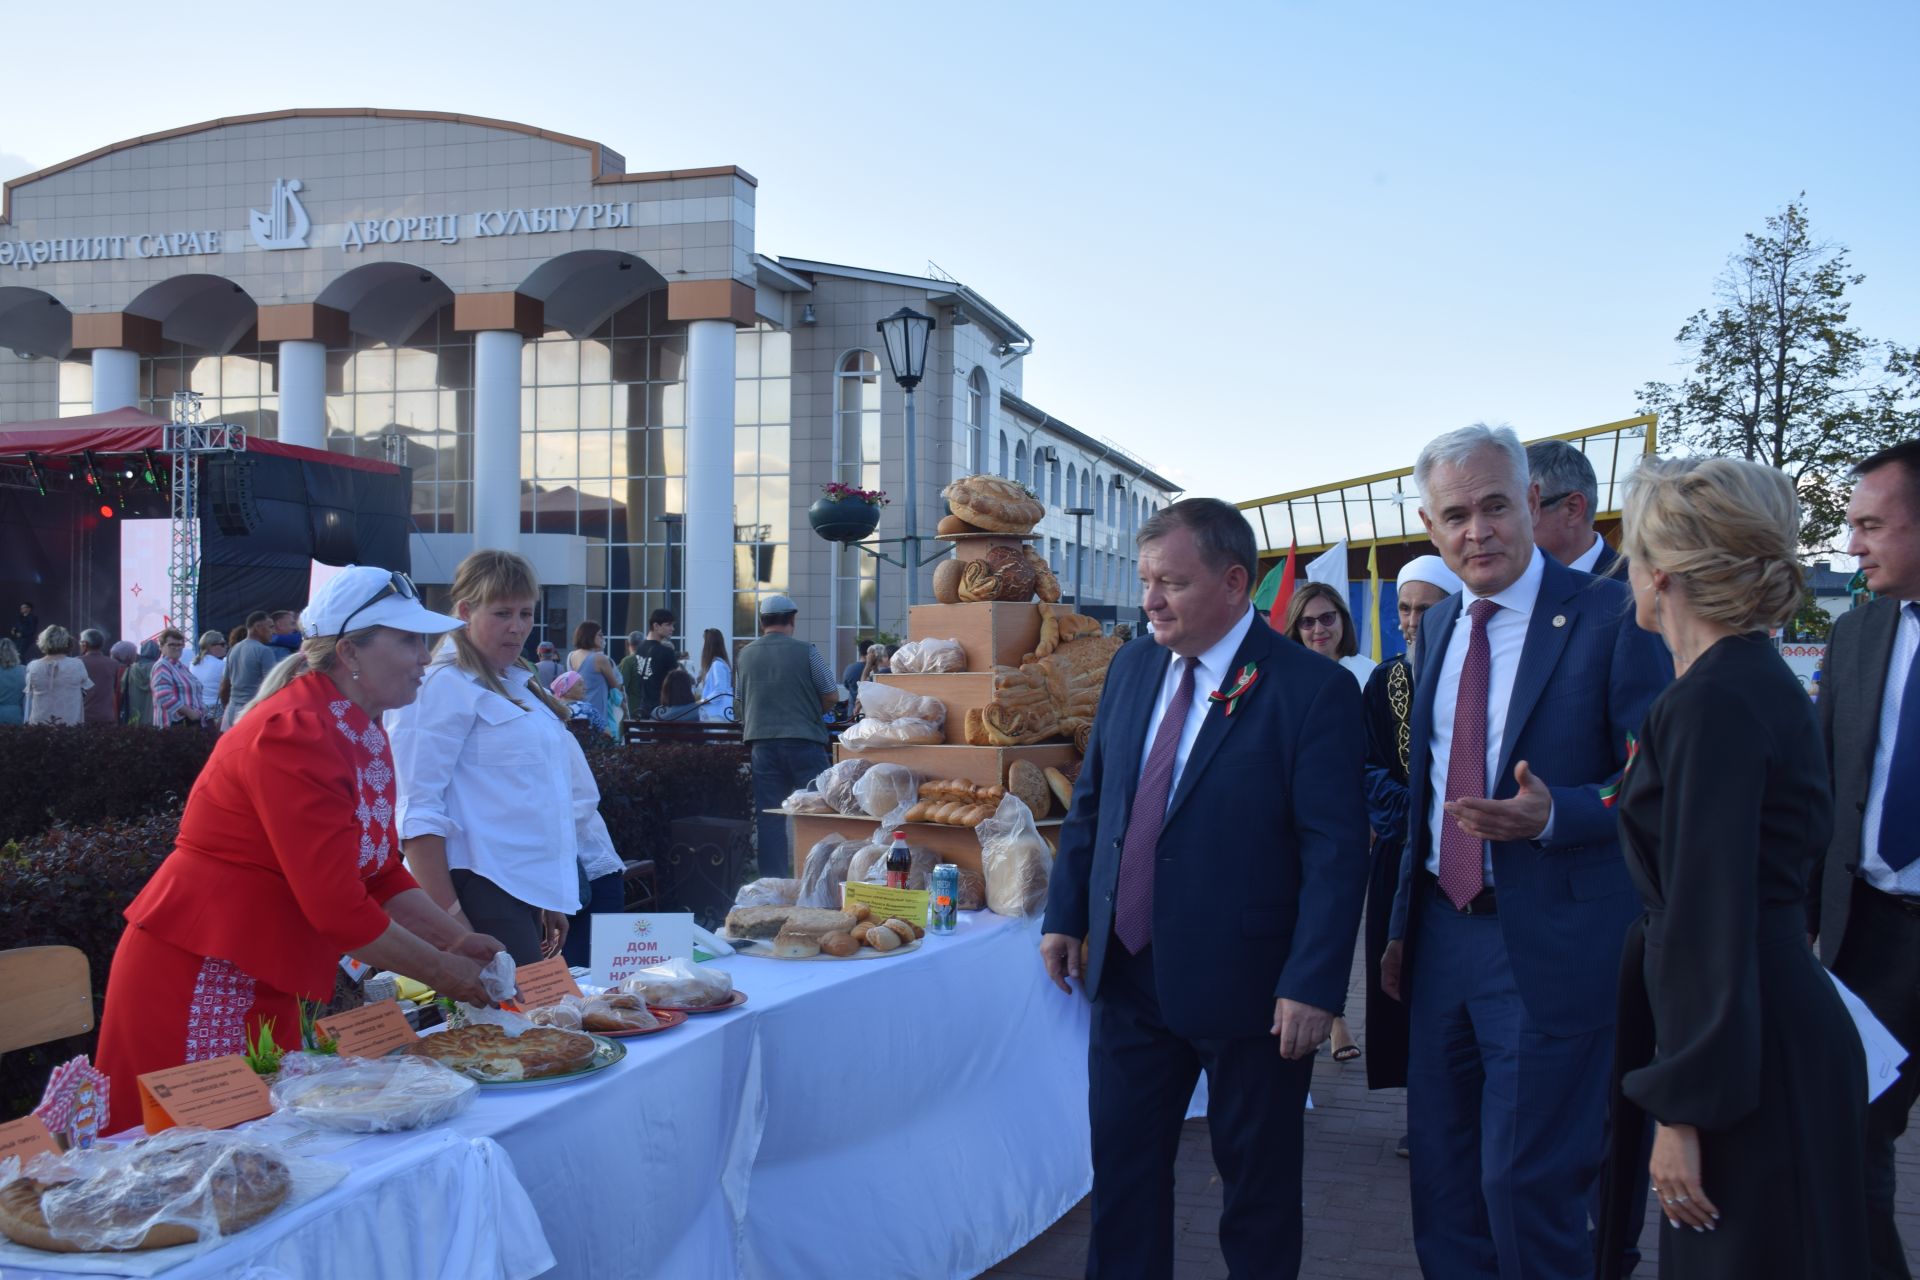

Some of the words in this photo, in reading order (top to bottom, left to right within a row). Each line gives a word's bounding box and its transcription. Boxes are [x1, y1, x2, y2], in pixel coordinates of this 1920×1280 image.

[341, 214, 459, 252] ДВОРЕЦ
[473, 202, 633, 238] КУЛЬТУРЫ
[135, 229, 222, 260] САРАЕ
[627, 942, 657, 952] ДОМ
